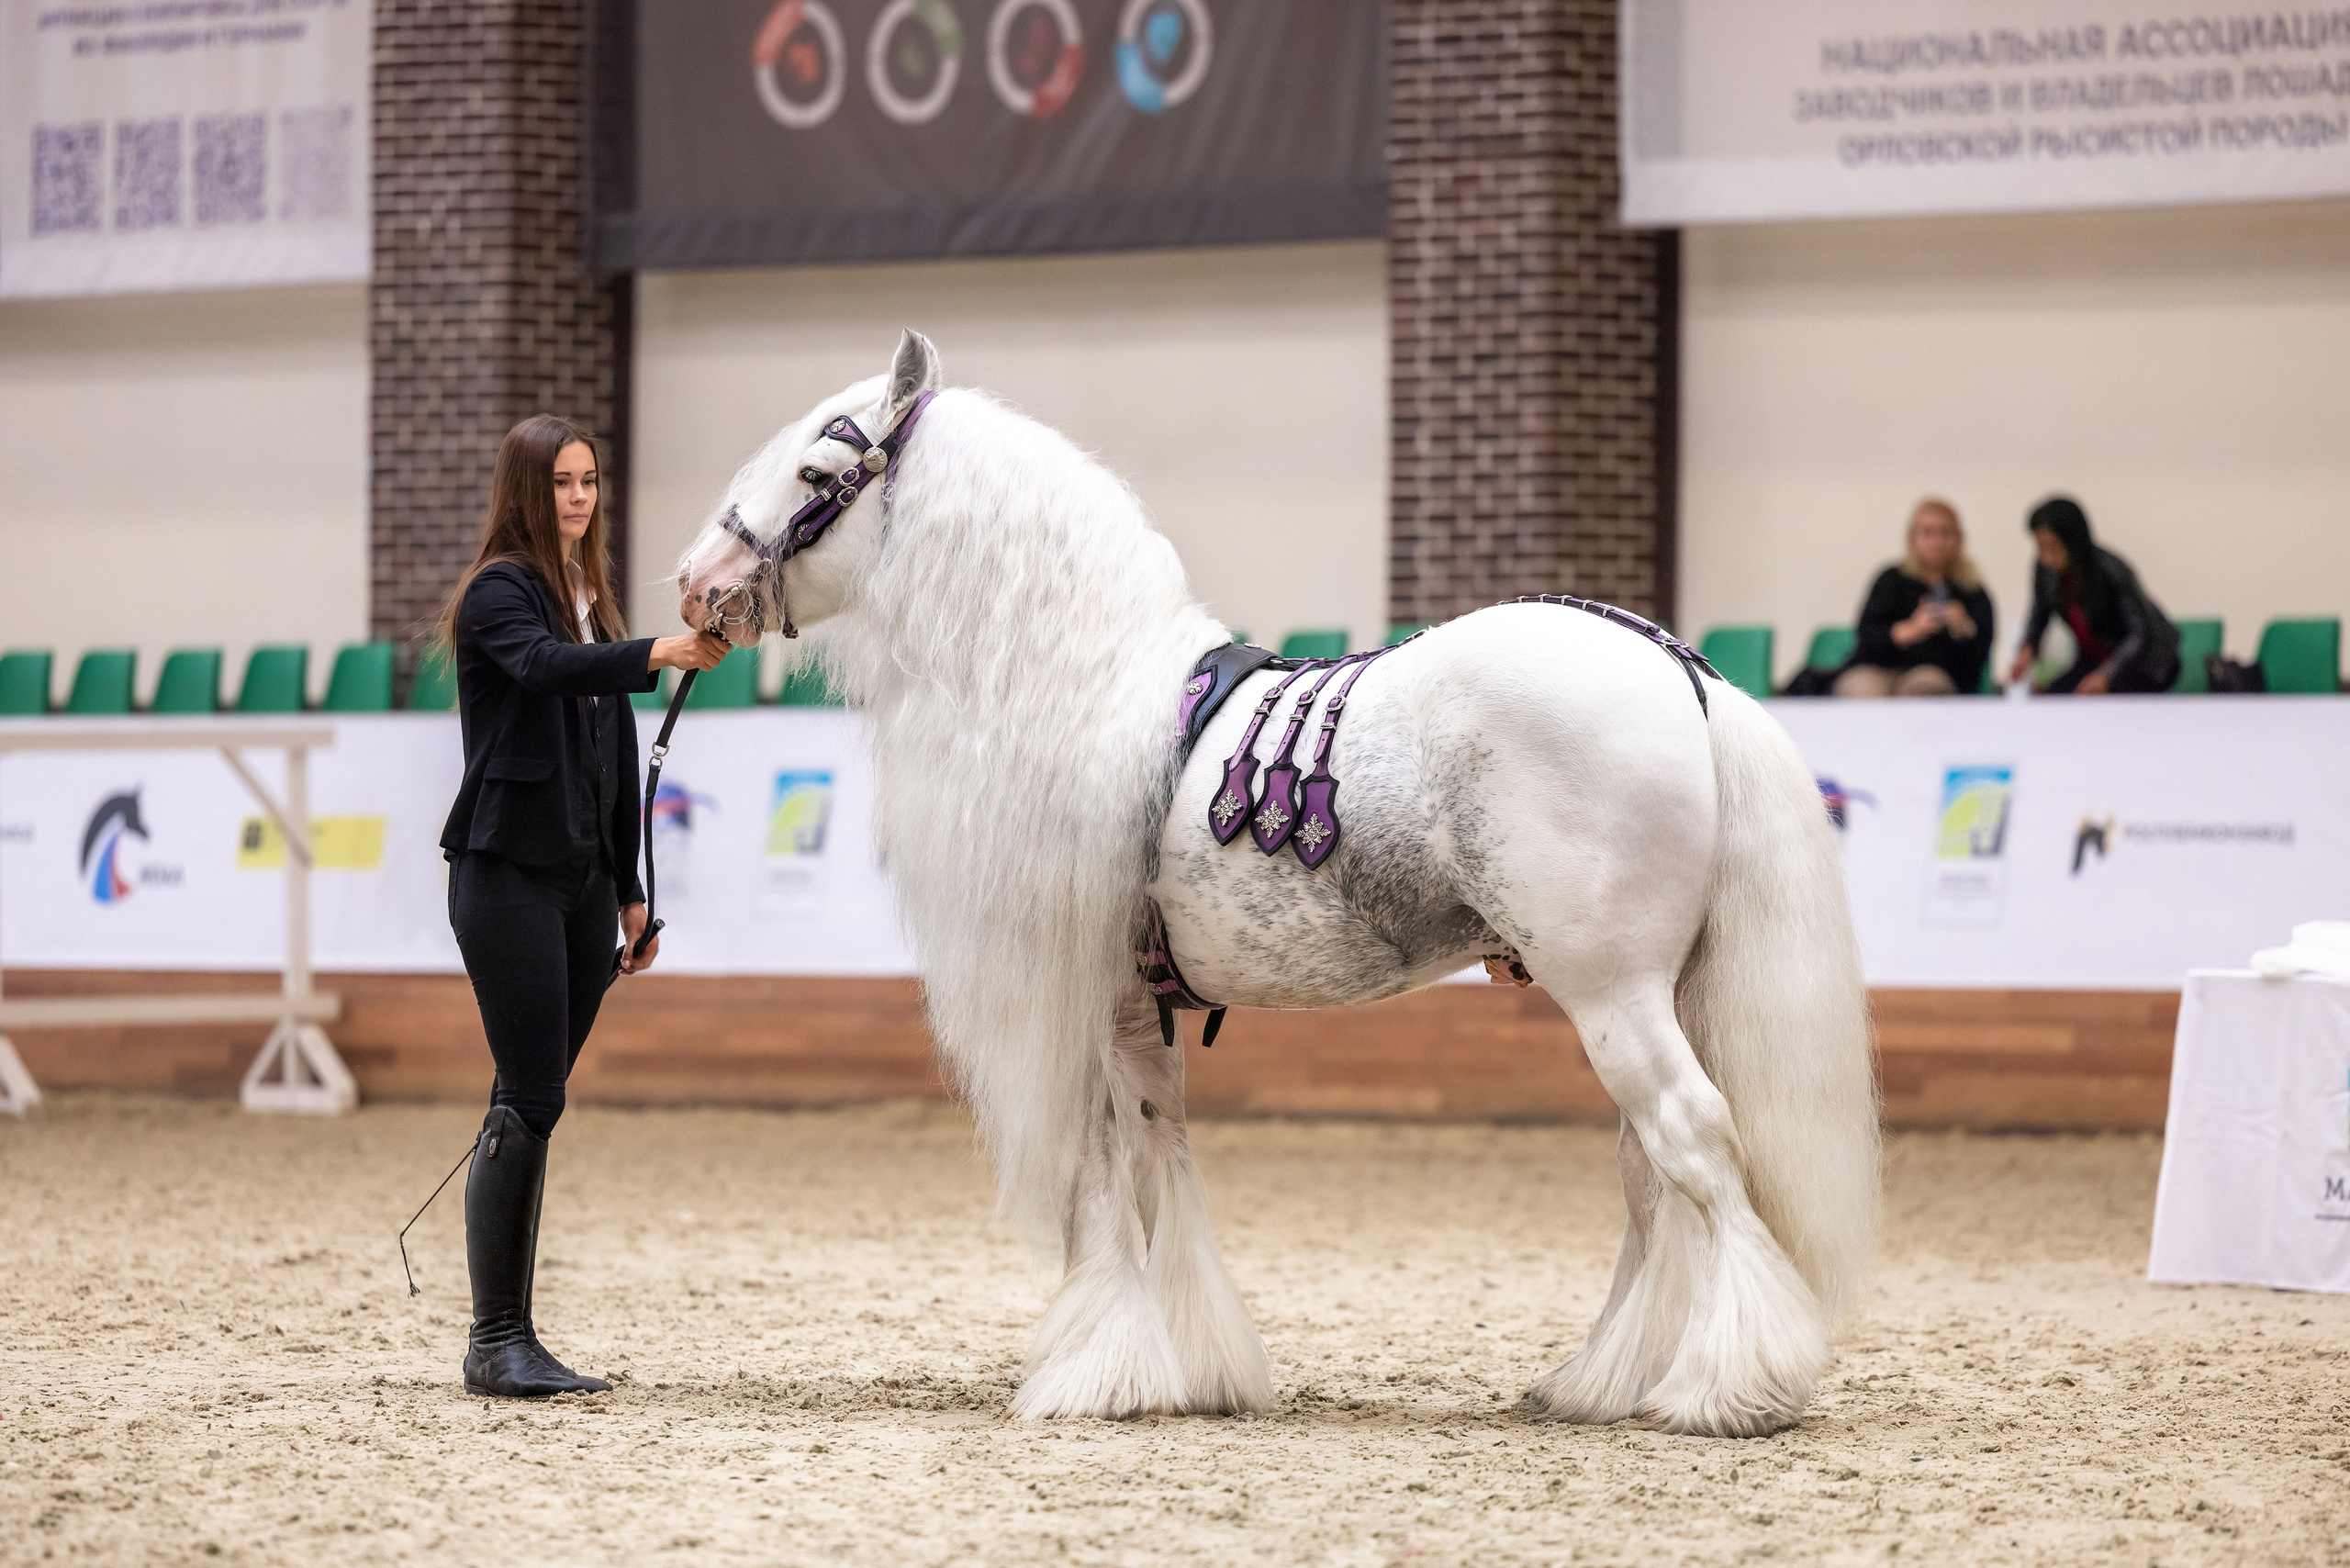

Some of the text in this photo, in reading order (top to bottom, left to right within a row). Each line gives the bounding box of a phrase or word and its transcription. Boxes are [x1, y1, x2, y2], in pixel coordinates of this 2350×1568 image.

[1820, 10, 2350, 73] НАЦИОНАЛЬНАЯ АССОЦИАЦИ
[1794, 84, 1990, 121] ЗАВОДЧИКОВ
[1999, 81, 2022, 109] И
[2029, 67, 2234, 111] ВЛАДЕЛЬЦЕВ
[1838, 110, 2348, 166] ОРЛОВСКОЙ РЫСИСТОЙ ПОРОДЫ
